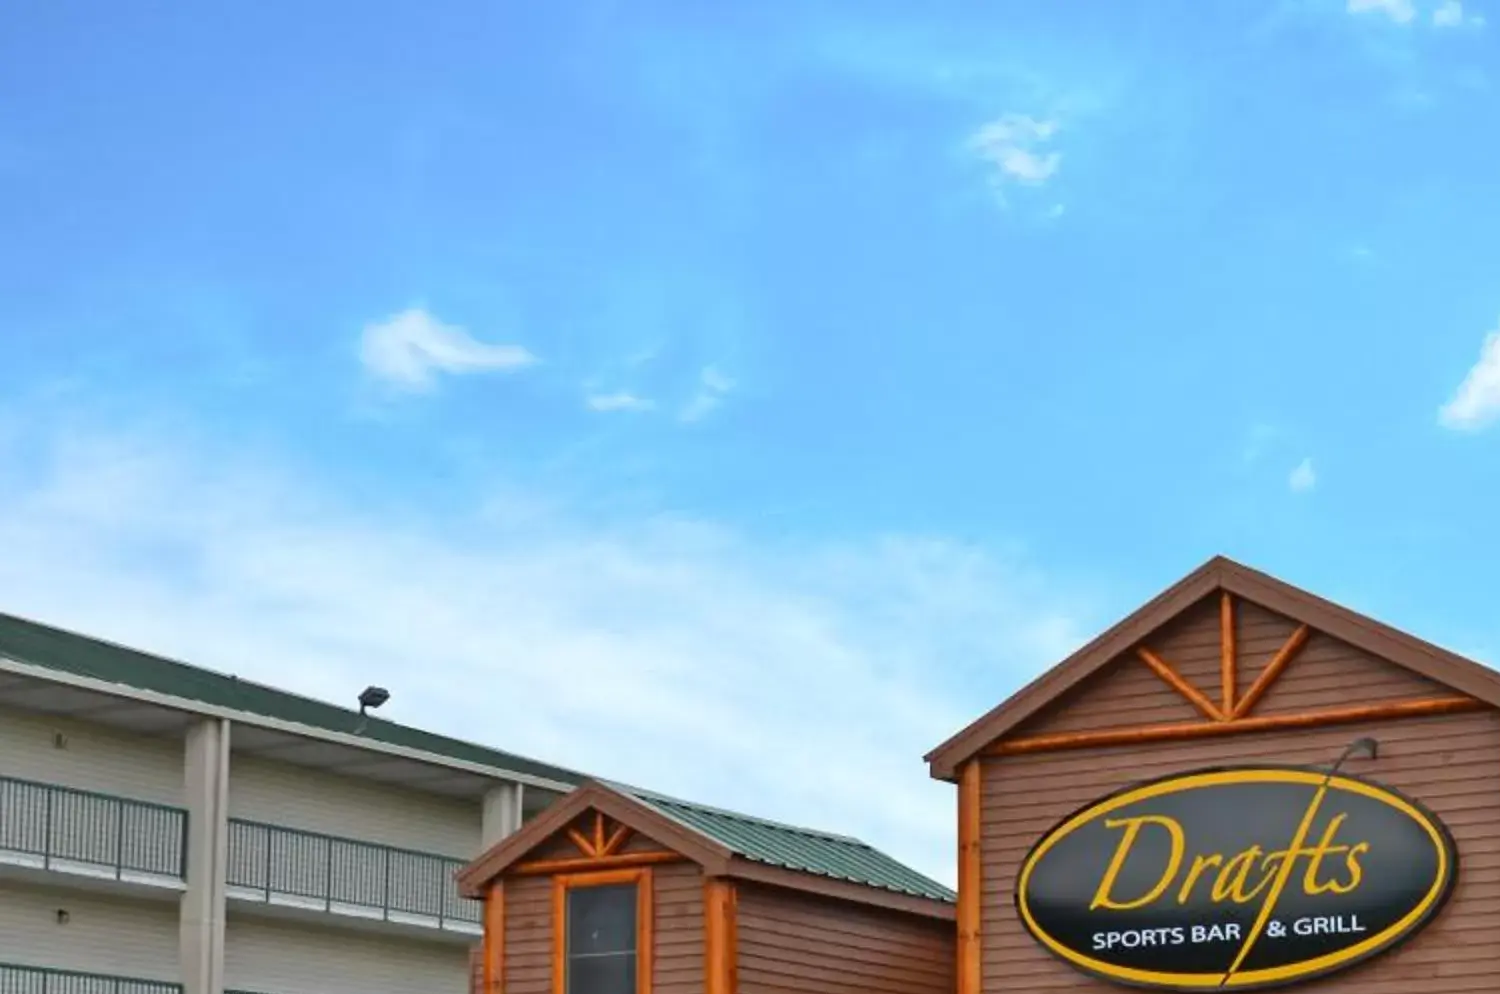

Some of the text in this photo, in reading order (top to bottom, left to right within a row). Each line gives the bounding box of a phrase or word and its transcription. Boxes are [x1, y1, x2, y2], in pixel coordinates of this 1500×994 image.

[1089, 784, 1370, 973] Drafts
[1092, 914, 1366, 950] SPORTS BAR & GRILL
